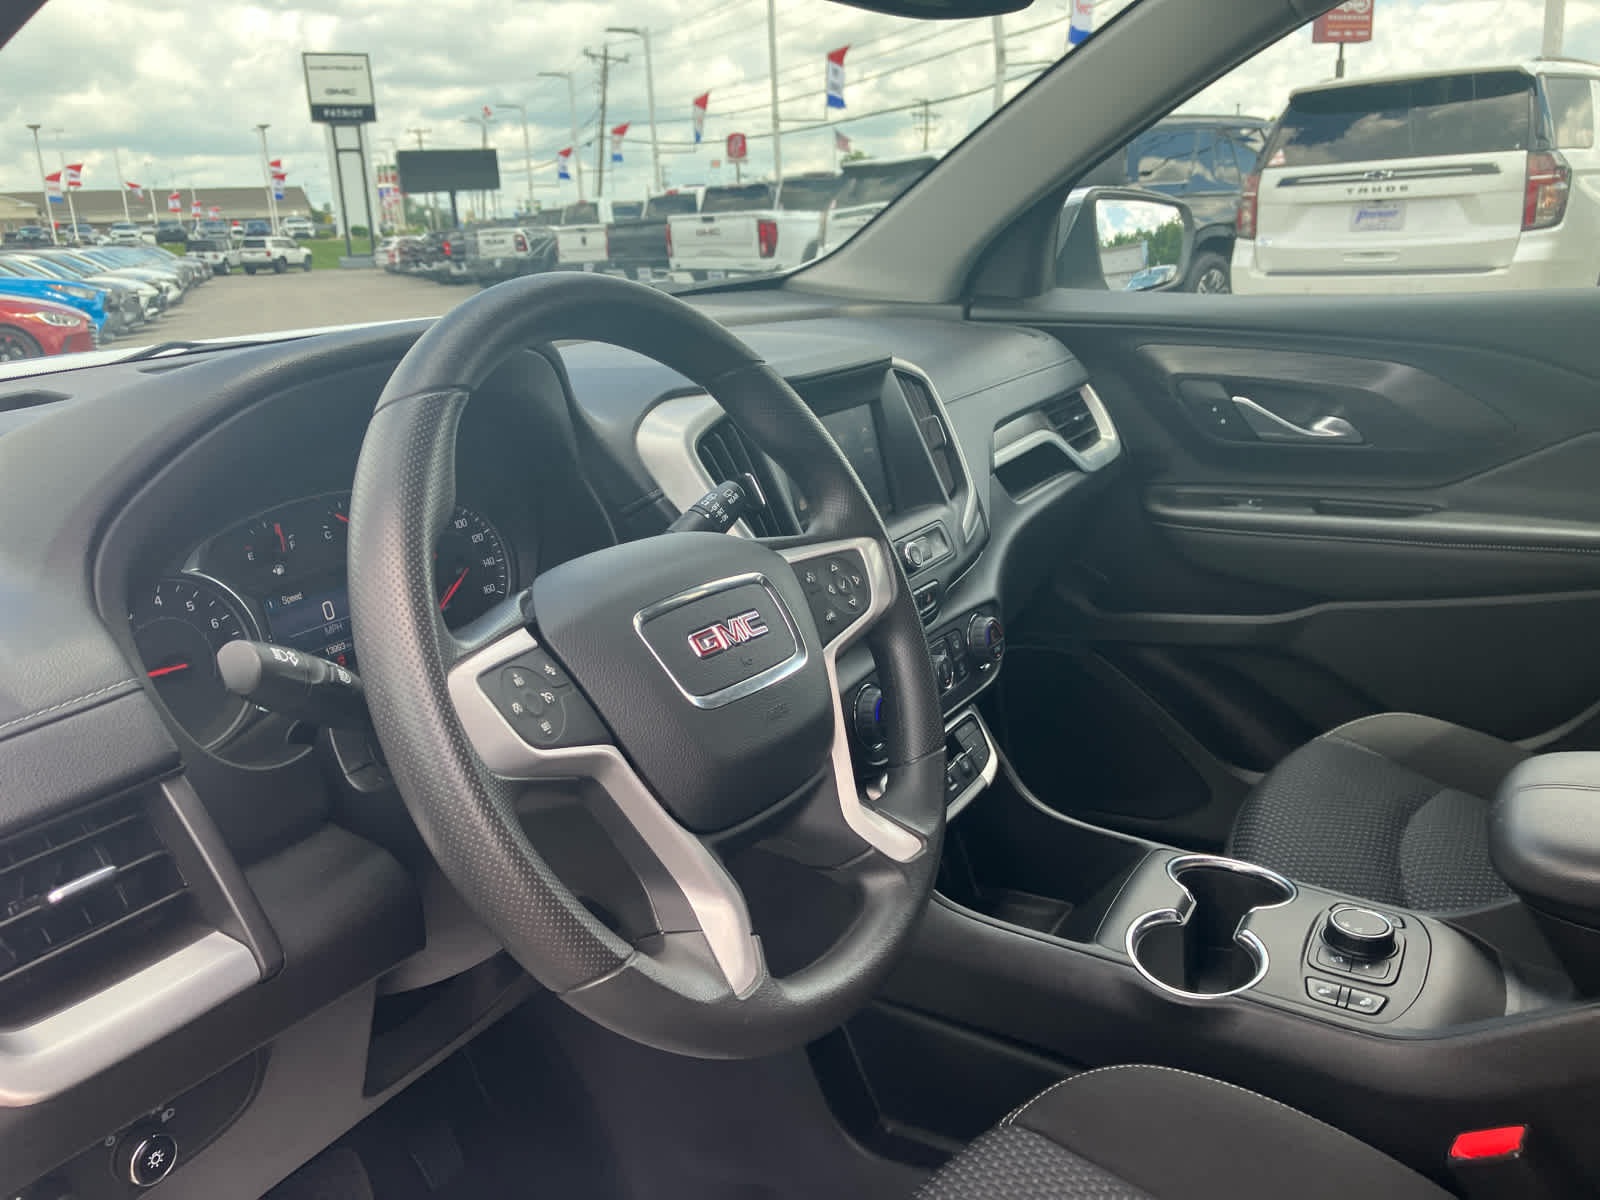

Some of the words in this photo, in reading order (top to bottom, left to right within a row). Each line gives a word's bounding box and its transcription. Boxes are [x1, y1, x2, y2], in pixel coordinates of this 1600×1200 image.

[455, 518, 468, 529] 100
[472, 533, 484, 543] 120
[483, 557, 495, 567] 140
[483, 584, 496, 594] 160
[154, 596, 162, 606] 4
[185, 600, 195, 612] 5
[210, 618, 219, 629] 6
[687, 609, 769, 657] GMC
